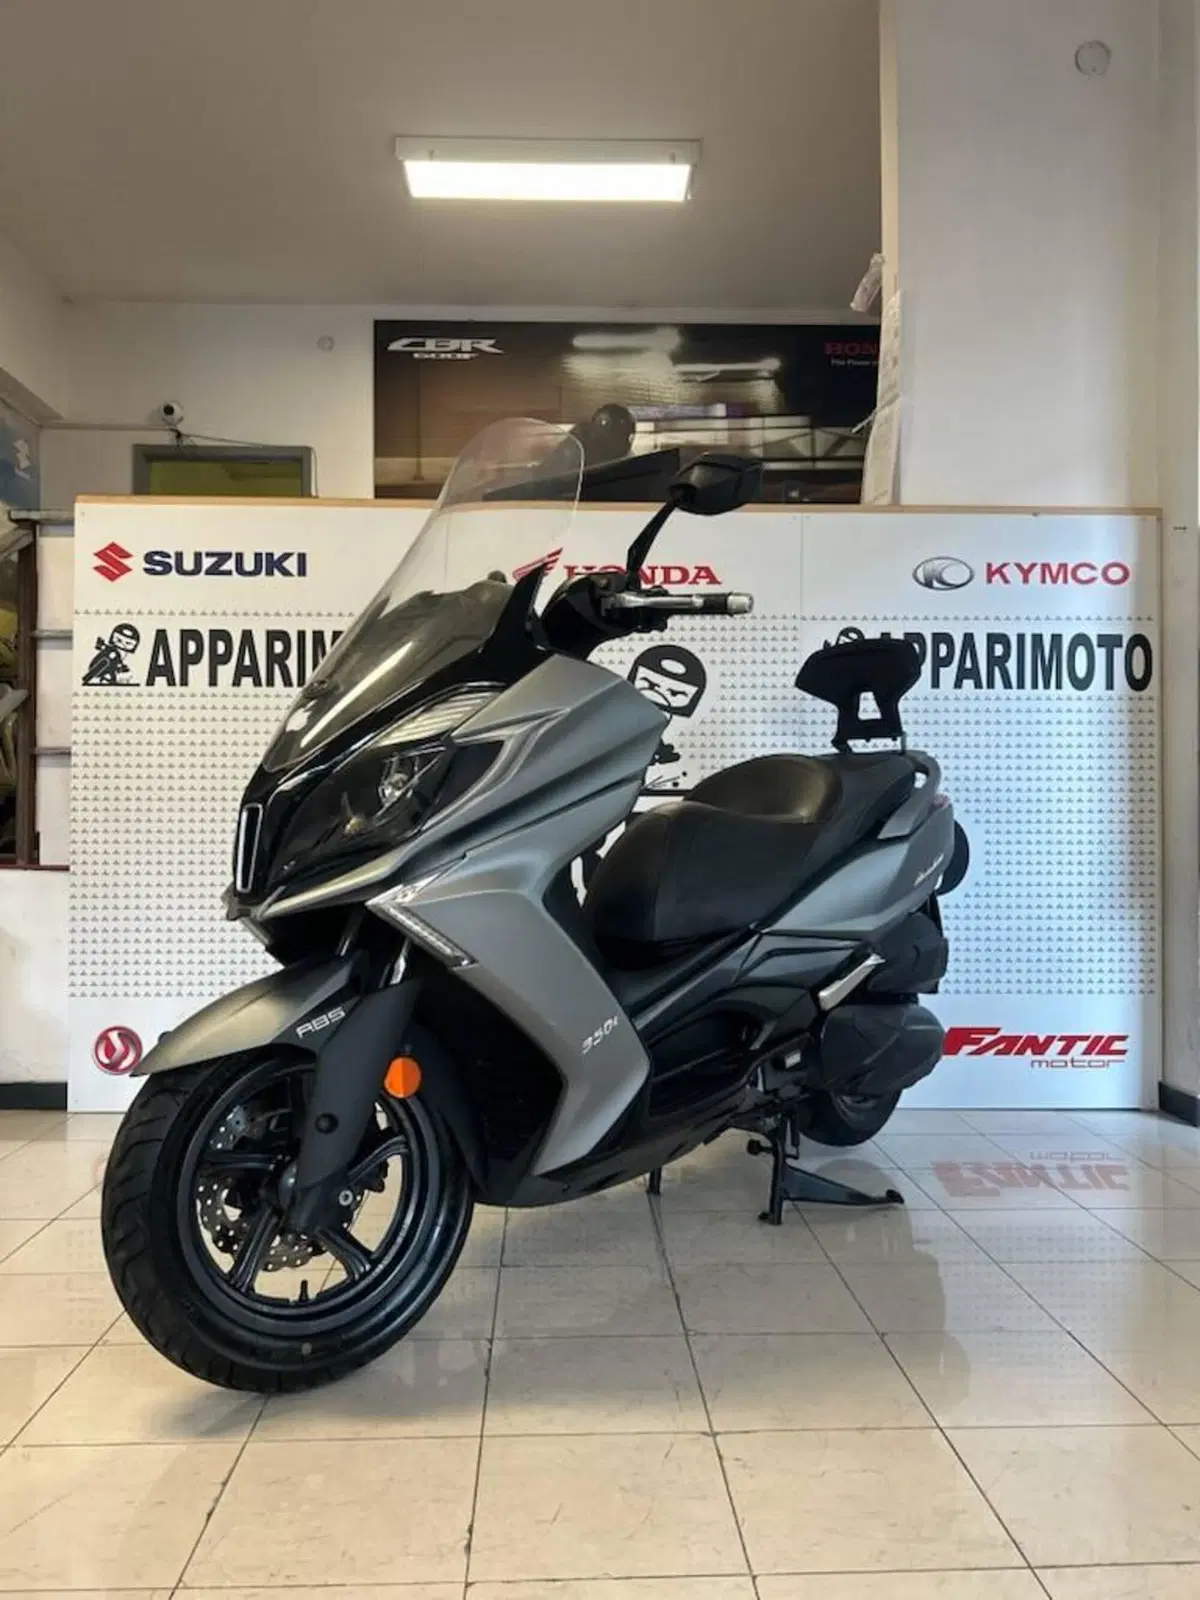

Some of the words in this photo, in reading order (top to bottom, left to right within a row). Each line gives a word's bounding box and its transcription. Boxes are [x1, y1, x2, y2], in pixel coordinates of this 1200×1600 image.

[387, 338, 504, 352] CBR
[143, 550, 308, 577] SUZUKI
[985, 562, 1131, 586] KYMCO
[879, 631, 1154, 691] PARIMOTO
[296, 1006, 346, 1039] ABS
[941, 1027, 1129, 1056] FANTIC
[1030, 1057, 1125, 1069] motor
